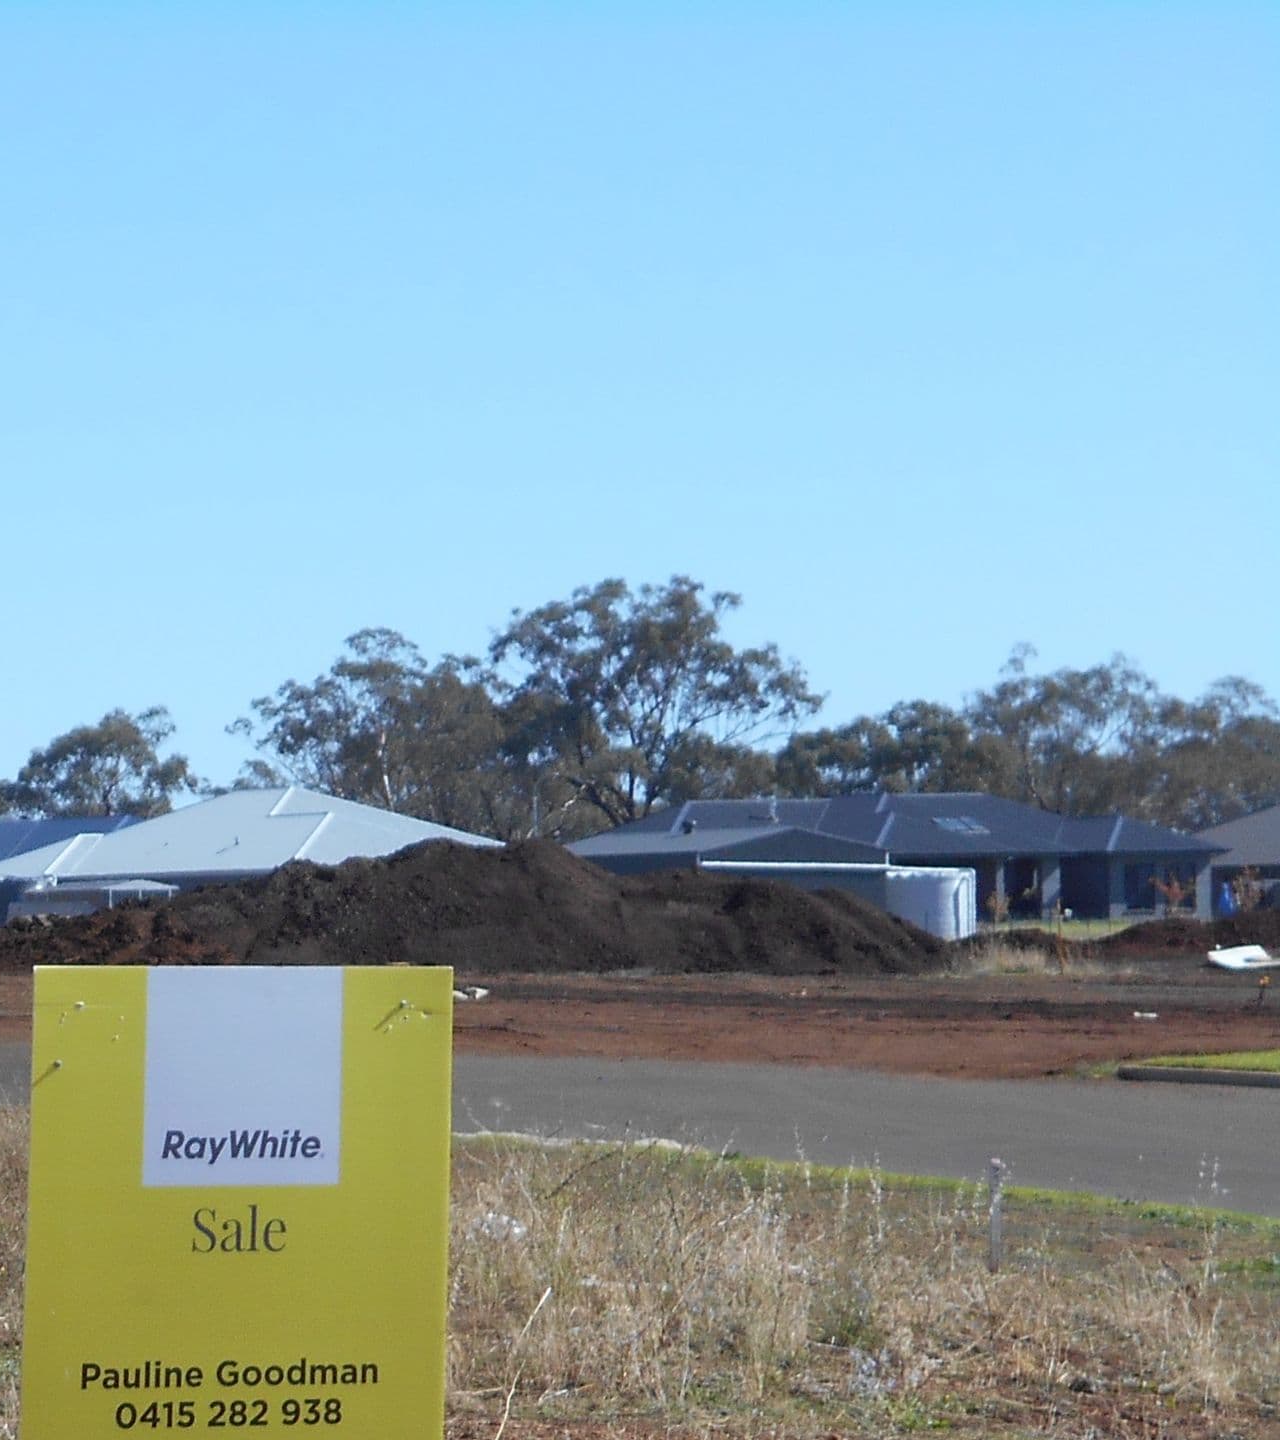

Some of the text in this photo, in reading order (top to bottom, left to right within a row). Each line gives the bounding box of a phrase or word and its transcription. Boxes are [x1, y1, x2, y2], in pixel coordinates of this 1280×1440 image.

[191, 1204, 287, 1253] Sale
[80, 1358, 378, 1389] Pauline Goodman
[115, 1398, 342, 1429] 0415 282 938
